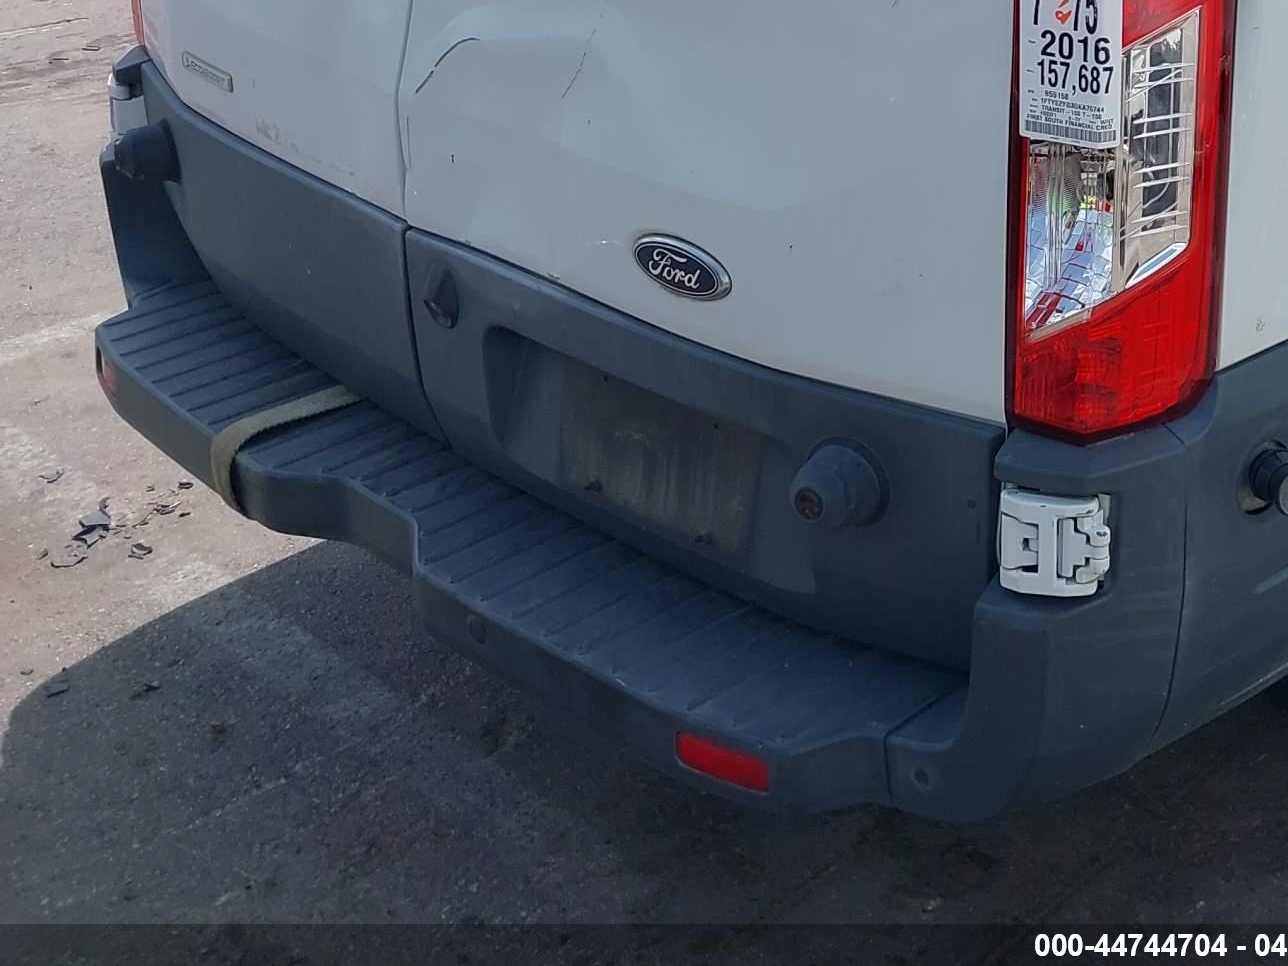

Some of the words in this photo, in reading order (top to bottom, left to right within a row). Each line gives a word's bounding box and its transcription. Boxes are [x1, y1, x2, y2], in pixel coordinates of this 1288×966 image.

[1040, 29, 1111, 65] 2016
[1037, 58, 1114, 96] 157,687
[648, 248, 702, 289] Ford
